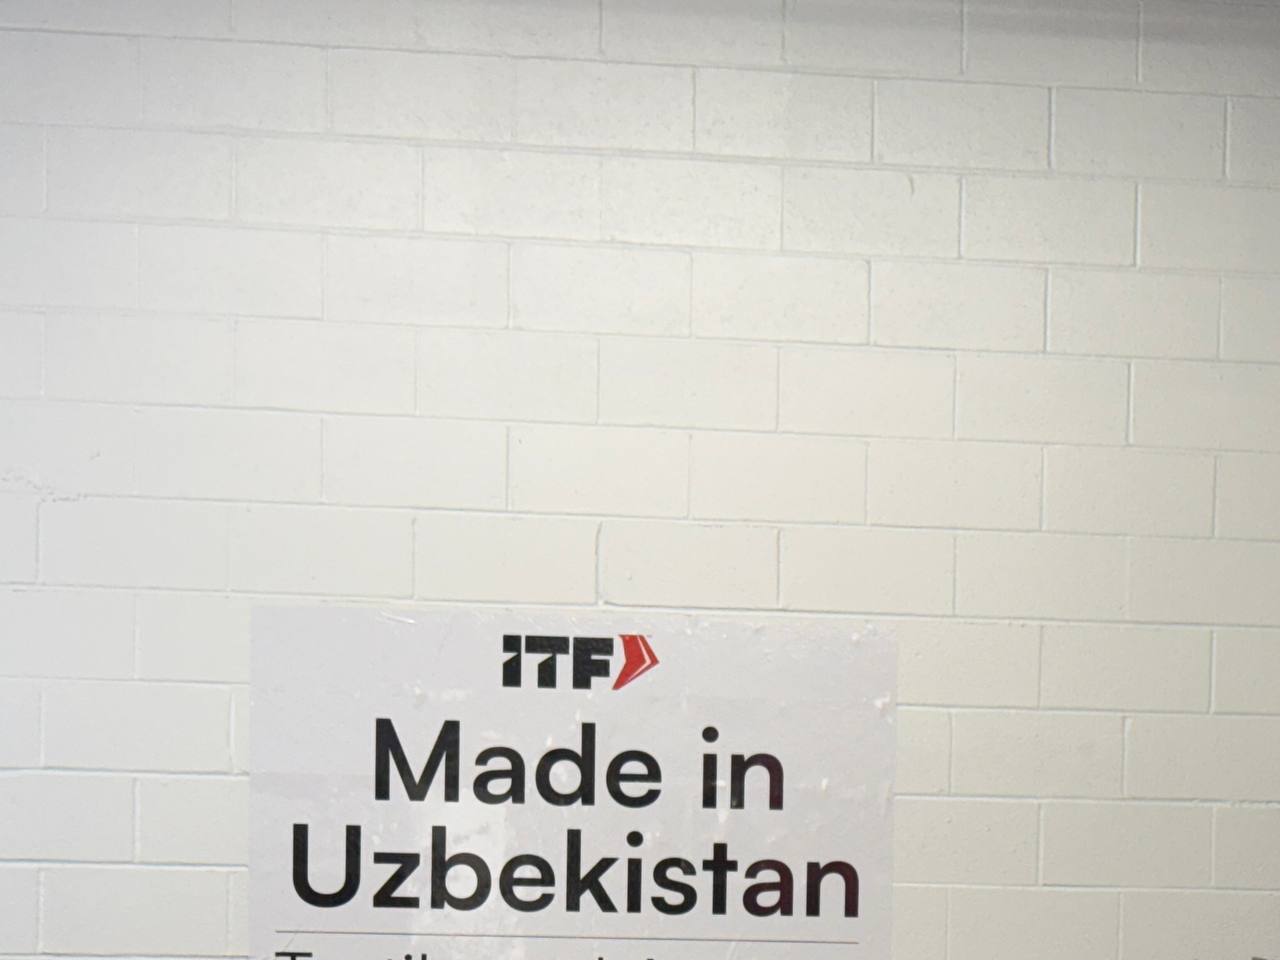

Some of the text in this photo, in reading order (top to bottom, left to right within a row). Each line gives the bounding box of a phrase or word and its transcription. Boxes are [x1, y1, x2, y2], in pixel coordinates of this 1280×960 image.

[502, 634, 614, 690] ITF
[374, 717, 784, 811] Made in
[292, 823, 860, 918] Uzbekistan
